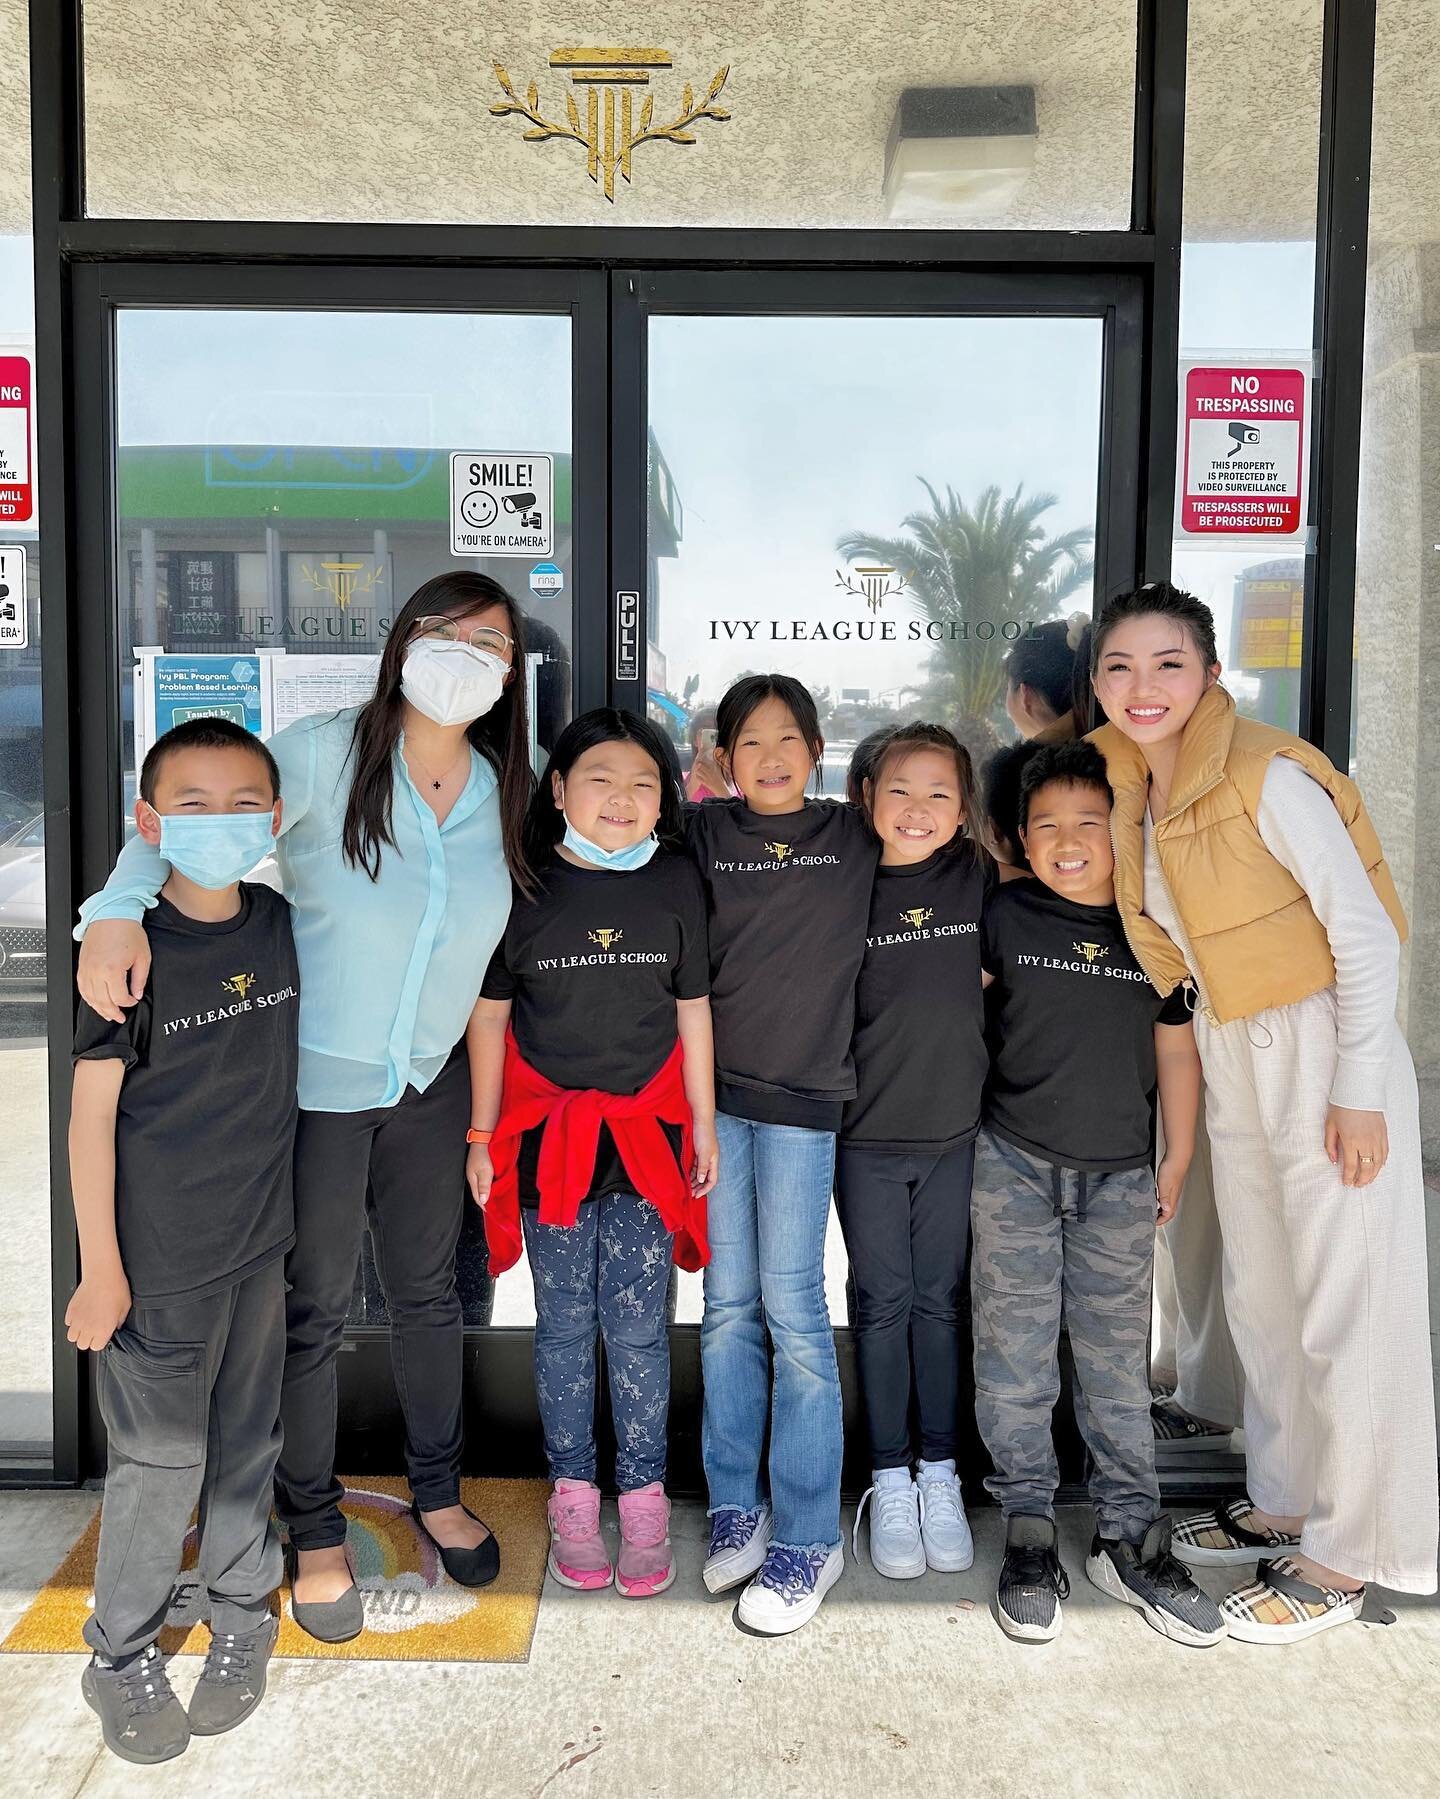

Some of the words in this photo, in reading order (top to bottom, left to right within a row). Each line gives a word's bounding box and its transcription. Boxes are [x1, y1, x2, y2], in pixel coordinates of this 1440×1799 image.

[1231, 376, 1260, 394] NO
[1196, 398, 1295, 413] TRESPASSING
[1211, 461, 1231, 470] THIS
[1232, 461, 1275, 470] PROPERTY
[469, 463, 533, 487] SMILE!
[1208, 472, 1217, 480] IS
[1218, 472, 1266, 481] PROTECTED
[1267, 473, 1279, 481] BY
[1198, 483, 1223, 491] VIDEO
[1225, 483, 1287, 492] SURVEILLANCE
[1192, 502, 1265, 513] TRESPASSERS
[1266, 503, 1291, 514] WILL
[1200, 516, 1213, 526] BE
[1215, 516, 1283, 527] PROSECUTED
[461, 534, 492, 546] YOU'RE
[494, 535, 506, 546] ON
[508, 536, 544, 547] CAMERA
[538, 576, 556, 586] ring
[172, 614, 226, 635] IVY
[238, 616, 367, 637] LEAGUE
[621, 595, 636, 661] PULL
[708, 620, 761, 641] IVY
[769, 620, 897, 641] LEAGUE
[908, 620, 1045, 641] SCHOOL
[159, 673, 172, 681] Ivy
[191, 673, 229, 681] Program:
[222, 684, 258, 692] Learning
[185, 709, 218, 719] Taught
[220, 708, 231, 716] by
[714, 861, 735, 872] IVY
[738, 861, 788, 871] LEAGUE
[792, 855, 840, 866] SCHOOL
[877, 929, 931, 946] LEAGUE
[933, 922, 978, 937] SCHOOL
[537, 959, 558, 970] IVY
[561, 953, 617, 968] LEAGUE
[620, 952, 668, 964] SCHOOL
[1017, 955, 1040, 966] IVY
[1043, 958, 1100, 975] LEAGUE
[1104, 967, 1152, 984] SCHOO
[163, 1017, 191, 1036] IVY
[195, 999, 253, 1026] LEAGUE
